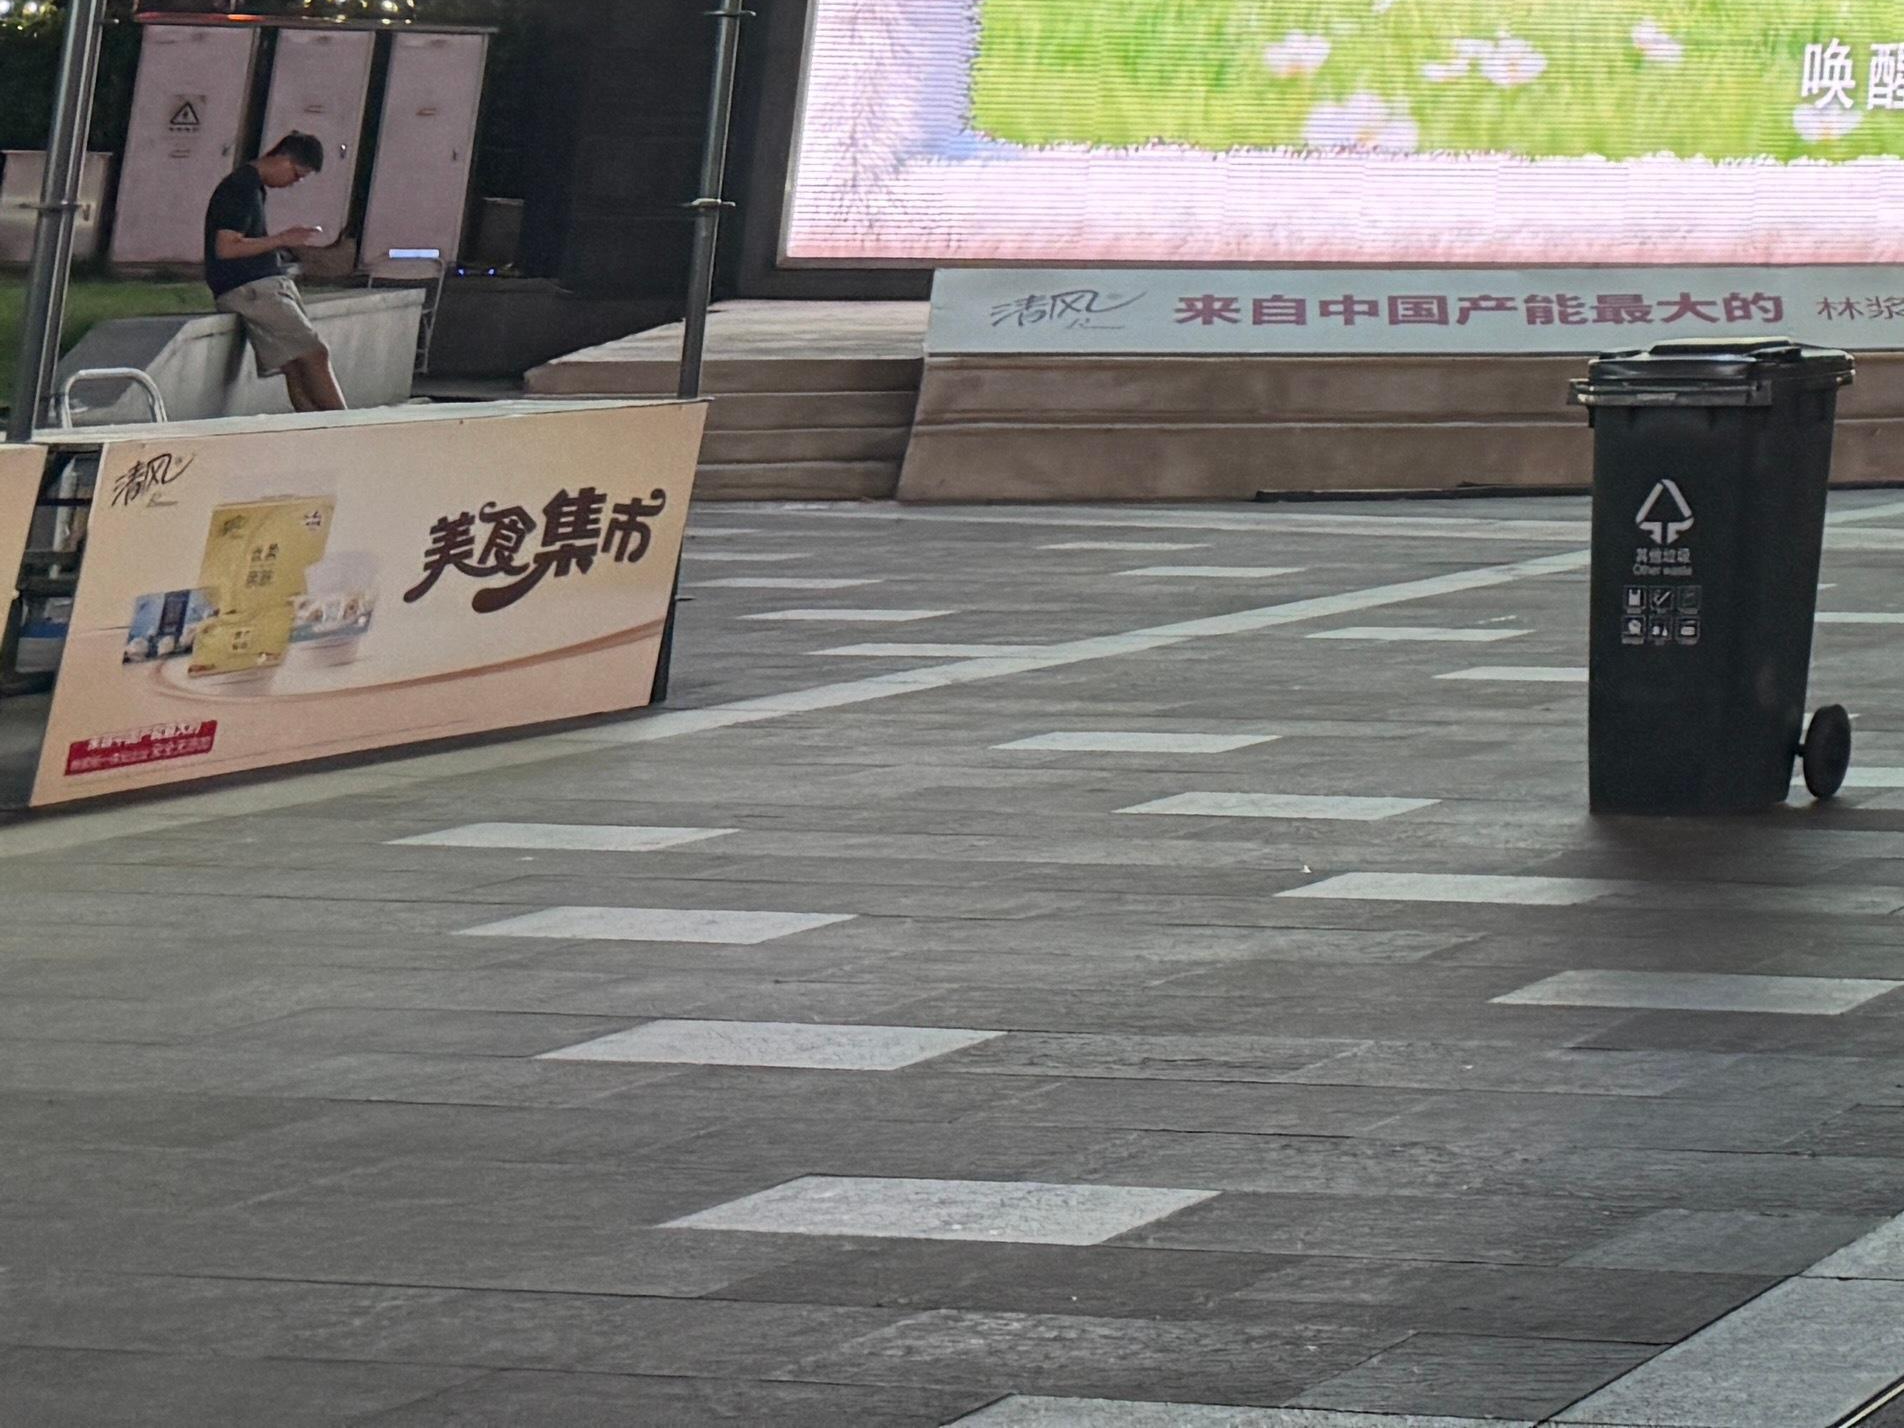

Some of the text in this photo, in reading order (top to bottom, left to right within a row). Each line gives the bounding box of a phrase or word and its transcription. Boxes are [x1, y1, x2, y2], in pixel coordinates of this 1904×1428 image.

[990, 289, 1148, 327] 清风
[1174, 292, 1785, 327] 来自中国产能最大的
[111, 453, 195, 507] 清风
[403, 486, 666, 614] 美食集市
